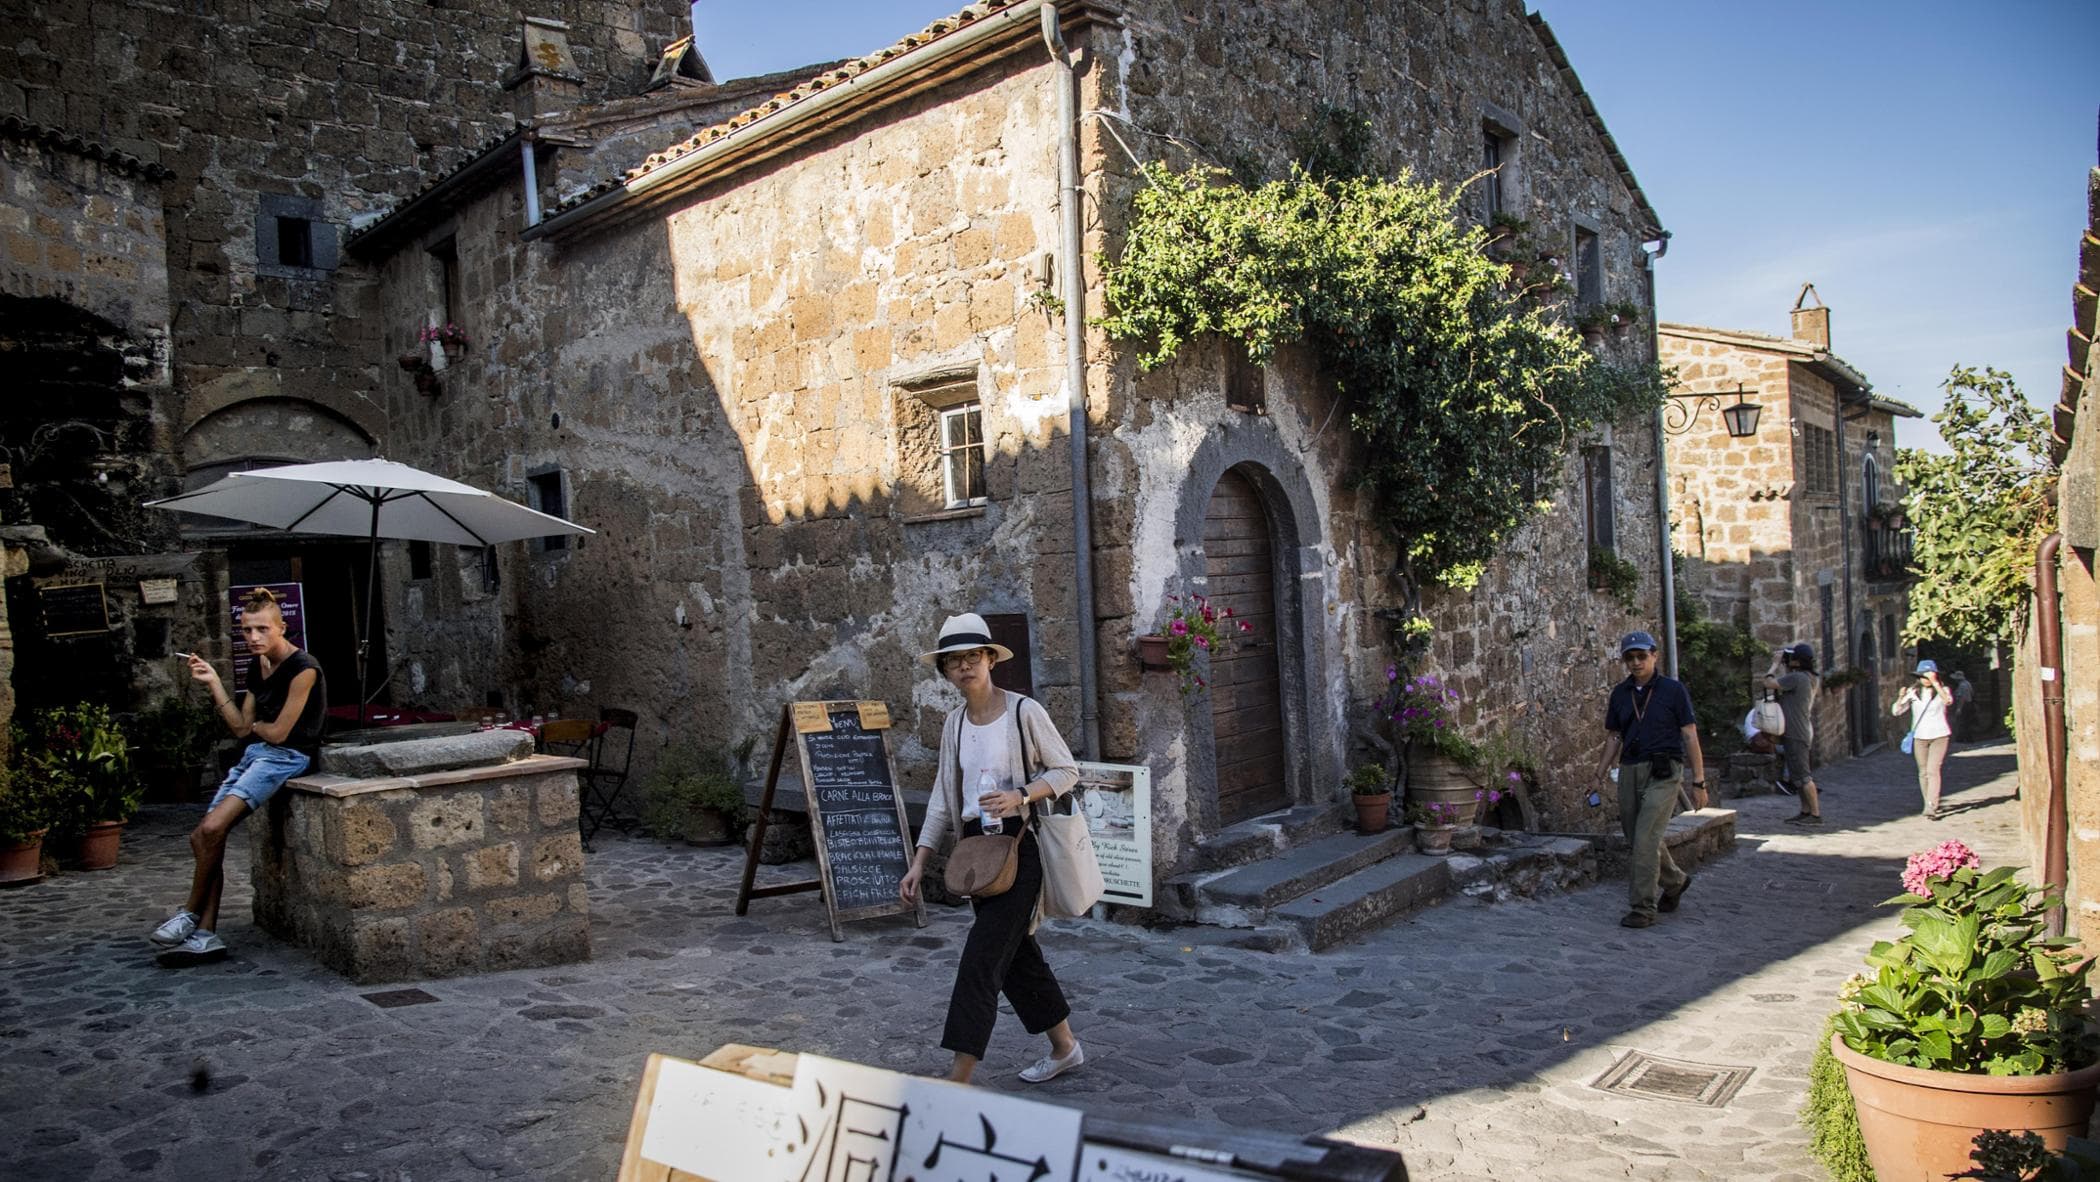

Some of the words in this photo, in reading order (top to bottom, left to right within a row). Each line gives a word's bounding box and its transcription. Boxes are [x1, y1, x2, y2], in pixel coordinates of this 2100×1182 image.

[821, 789, 849, 802] CARNE
[852, 790, 870, 802] ALLA
[836, 875, 899, 886] PROSCIUTTO
